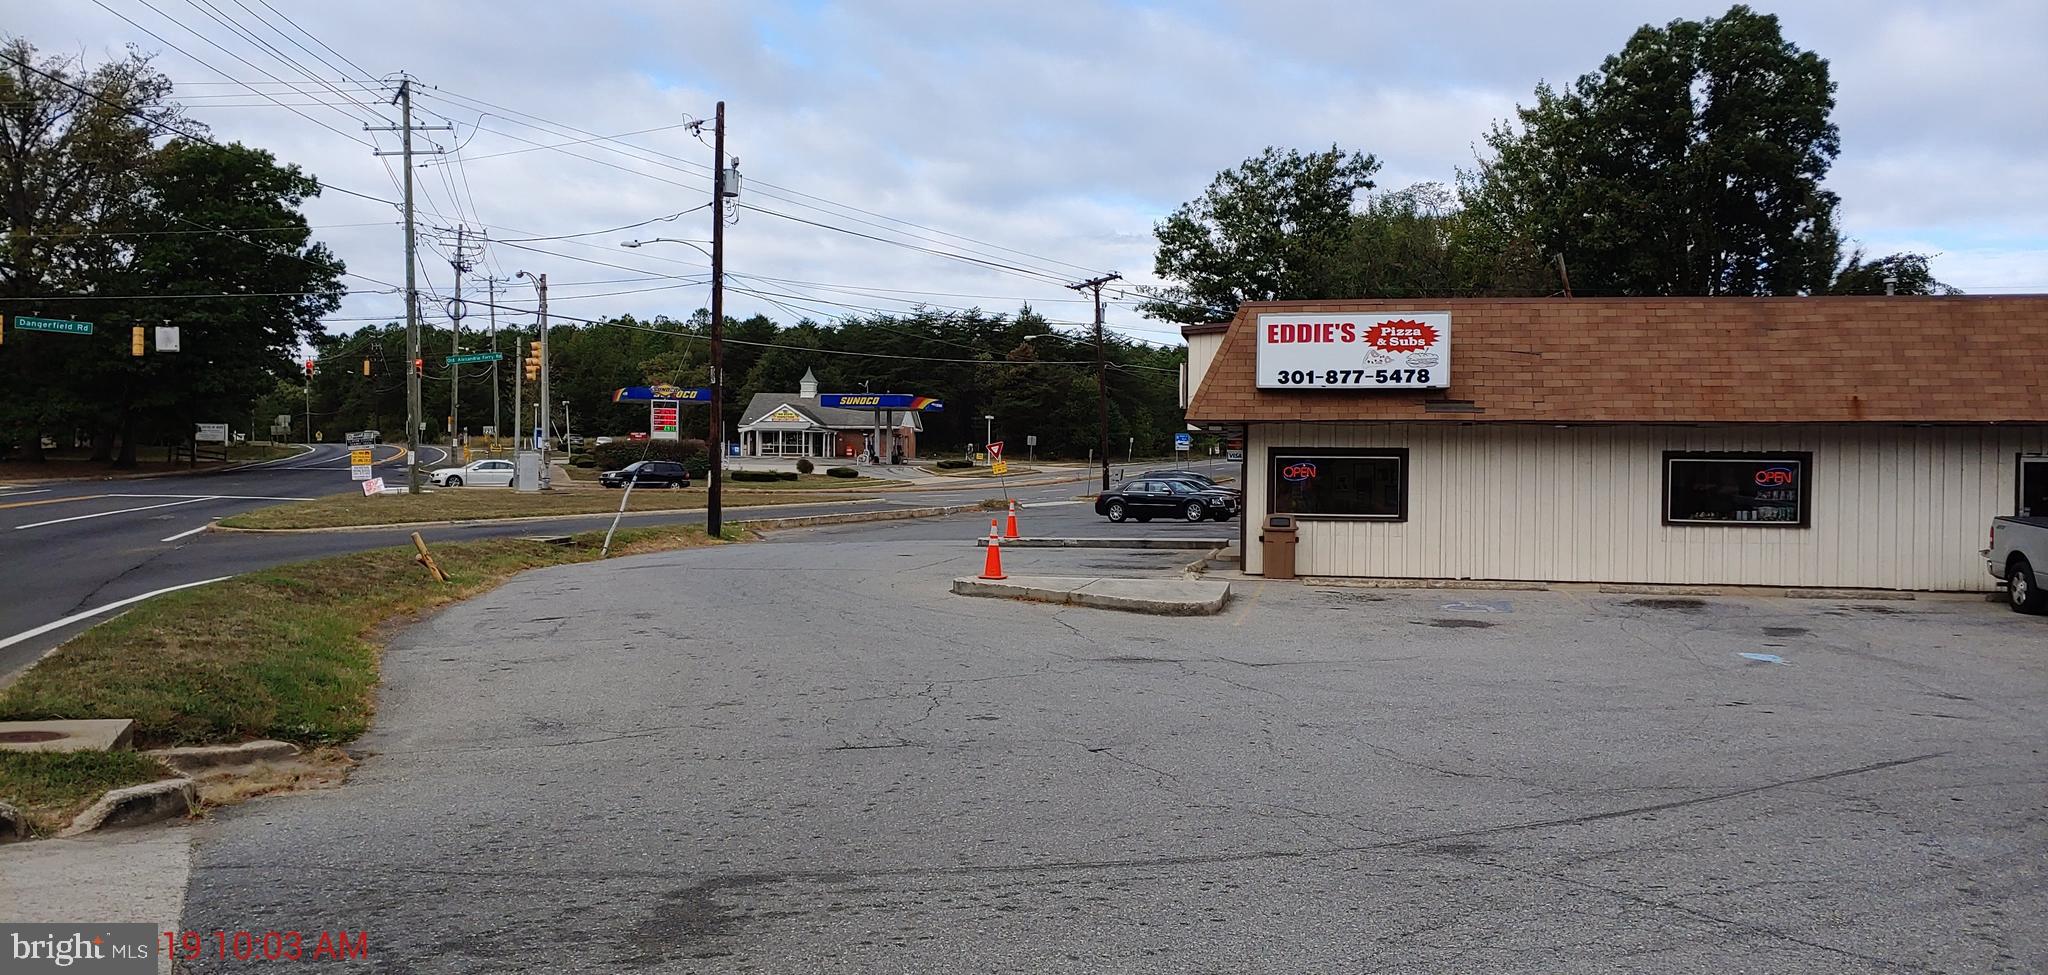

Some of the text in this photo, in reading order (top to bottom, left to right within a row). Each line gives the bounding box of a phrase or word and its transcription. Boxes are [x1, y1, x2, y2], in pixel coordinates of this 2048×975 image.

[19, 319, 89, 332] Dangerfield Rd
[1380, 326, 1422, 337] Pizza
[1267, 323, 1356, 344] EDDIE'S
[1376, 336, 1426, 347] & Subs
[1277, 369, 1430, 384] 301-877-5478
[840, 396, 880, 405] SUNOCO
[1283, 466, 1317, 478] OPEN
[1755, 471, 1792, 483] OPEN
